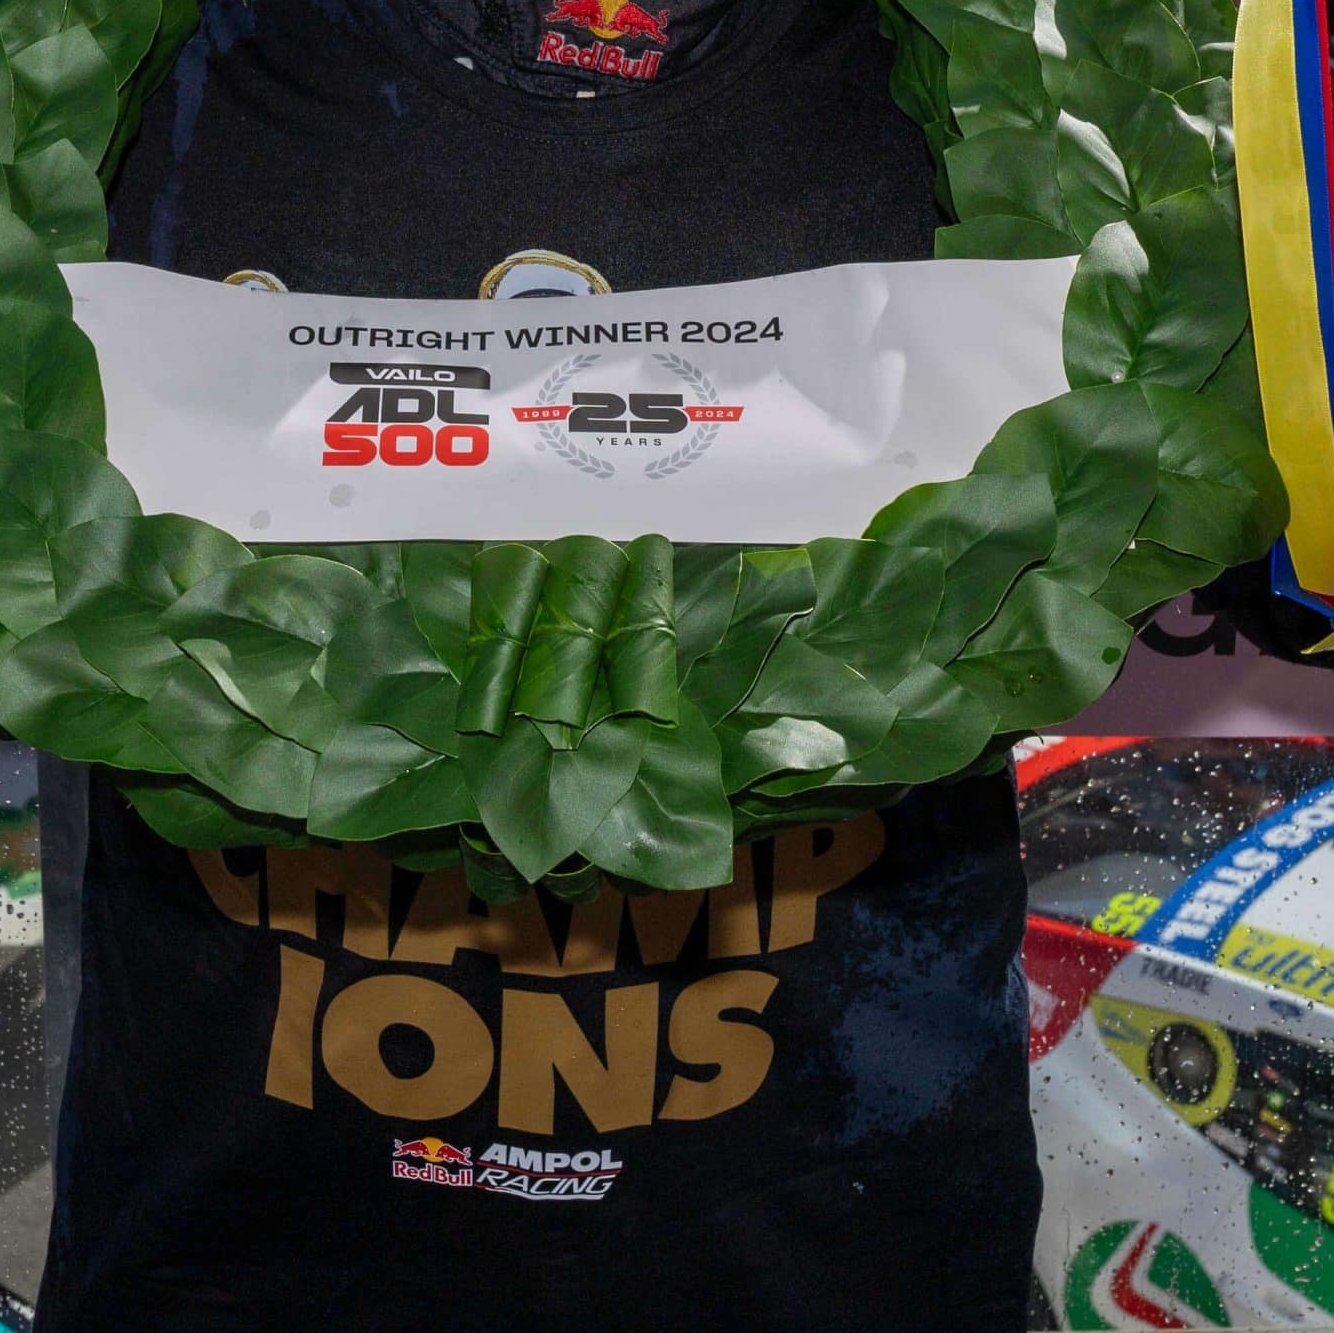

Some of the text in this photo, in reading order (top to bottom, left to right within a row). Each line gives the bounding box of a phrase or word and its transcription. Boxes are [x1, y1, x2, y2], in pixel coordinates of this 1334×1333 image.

[288, 316, 784, 352] OUTRIGHT WINNER 2024
[365, 367, 455, 383] VAILO
[328, 387, 490, 425] ADL
[522, 392, 736, 434] 1999 25 2024
[322, 423, 490, 467] 500
[596, 436, 662, 447] YEARS
[265, 943, 780, 1135] IONS
[479, 1142, 623, 1173] AMPOL
[476, 1167, 616, 1195] RACING
